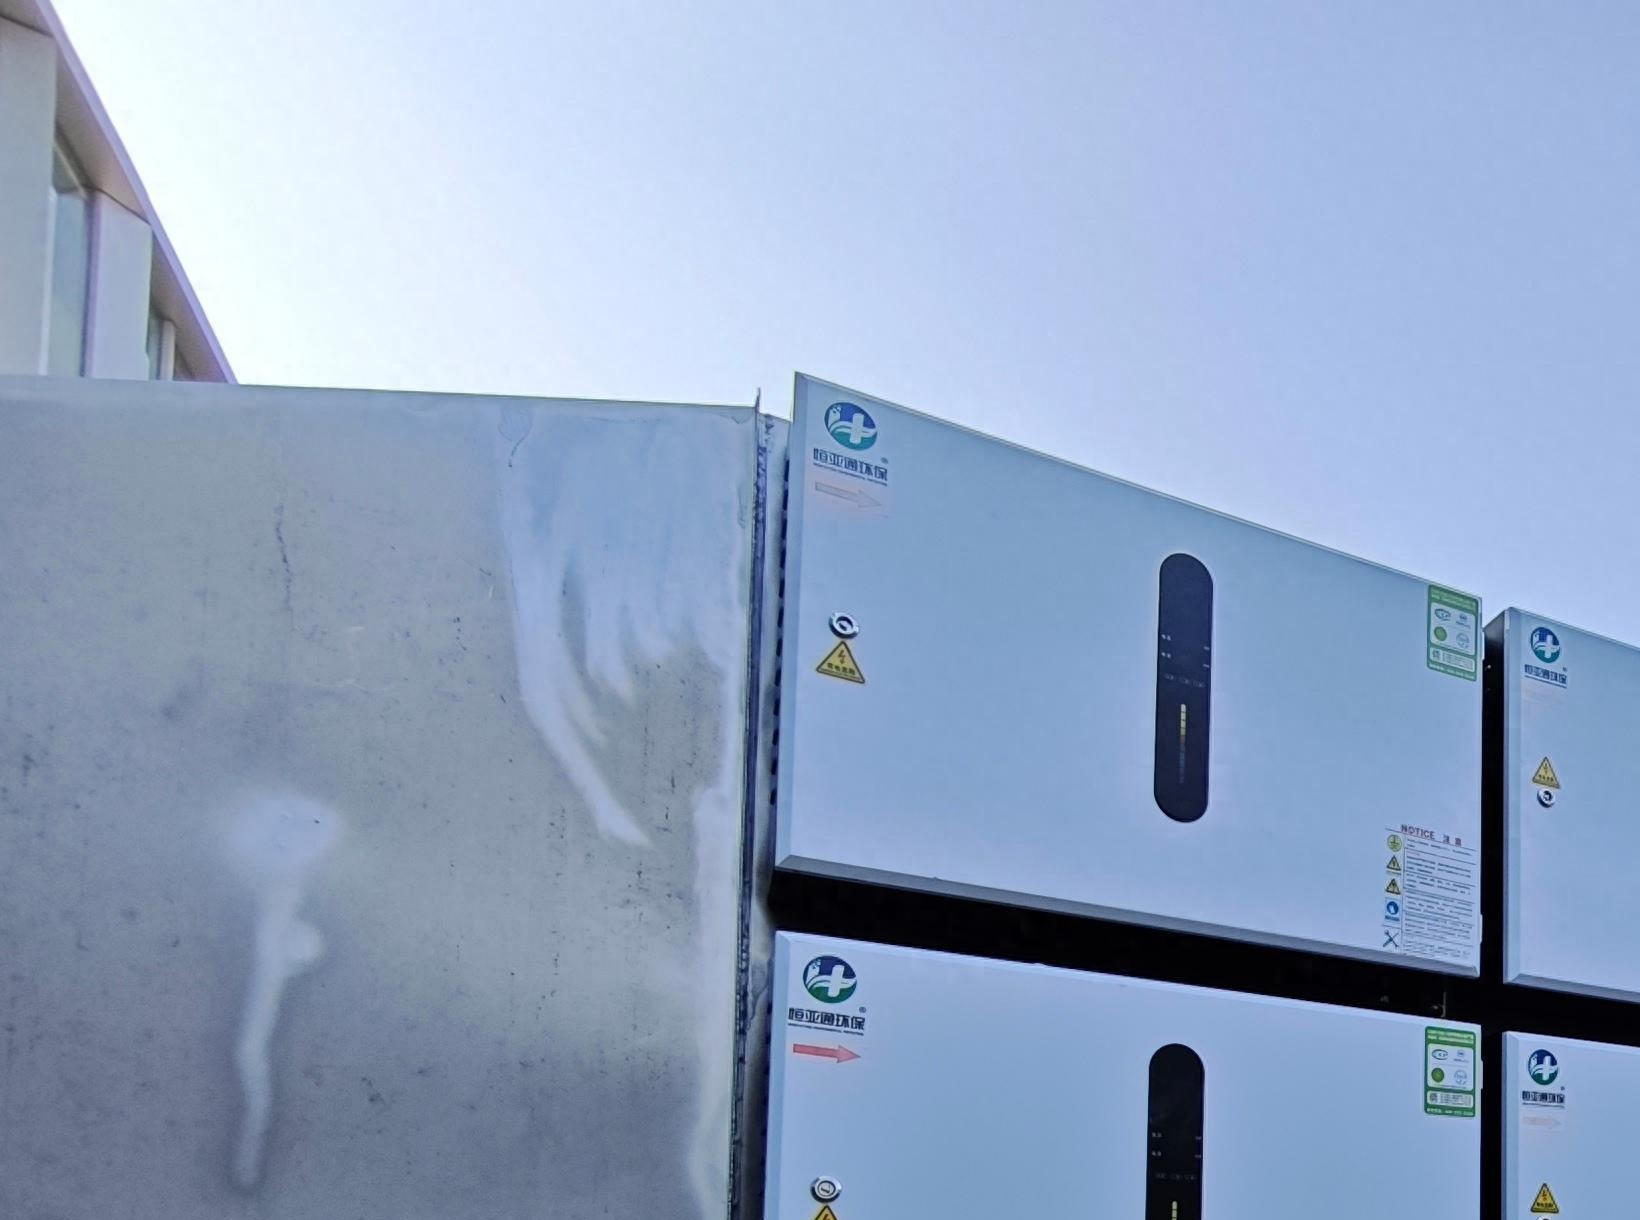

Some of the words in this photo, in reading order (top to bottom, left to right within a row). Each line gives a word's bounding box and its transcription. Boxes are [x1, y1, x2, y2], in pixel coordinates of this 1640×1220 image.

[1400, 824, 1435, 840] NOTICE
[788, 1007, 865, 1031] 恒亚通环保
